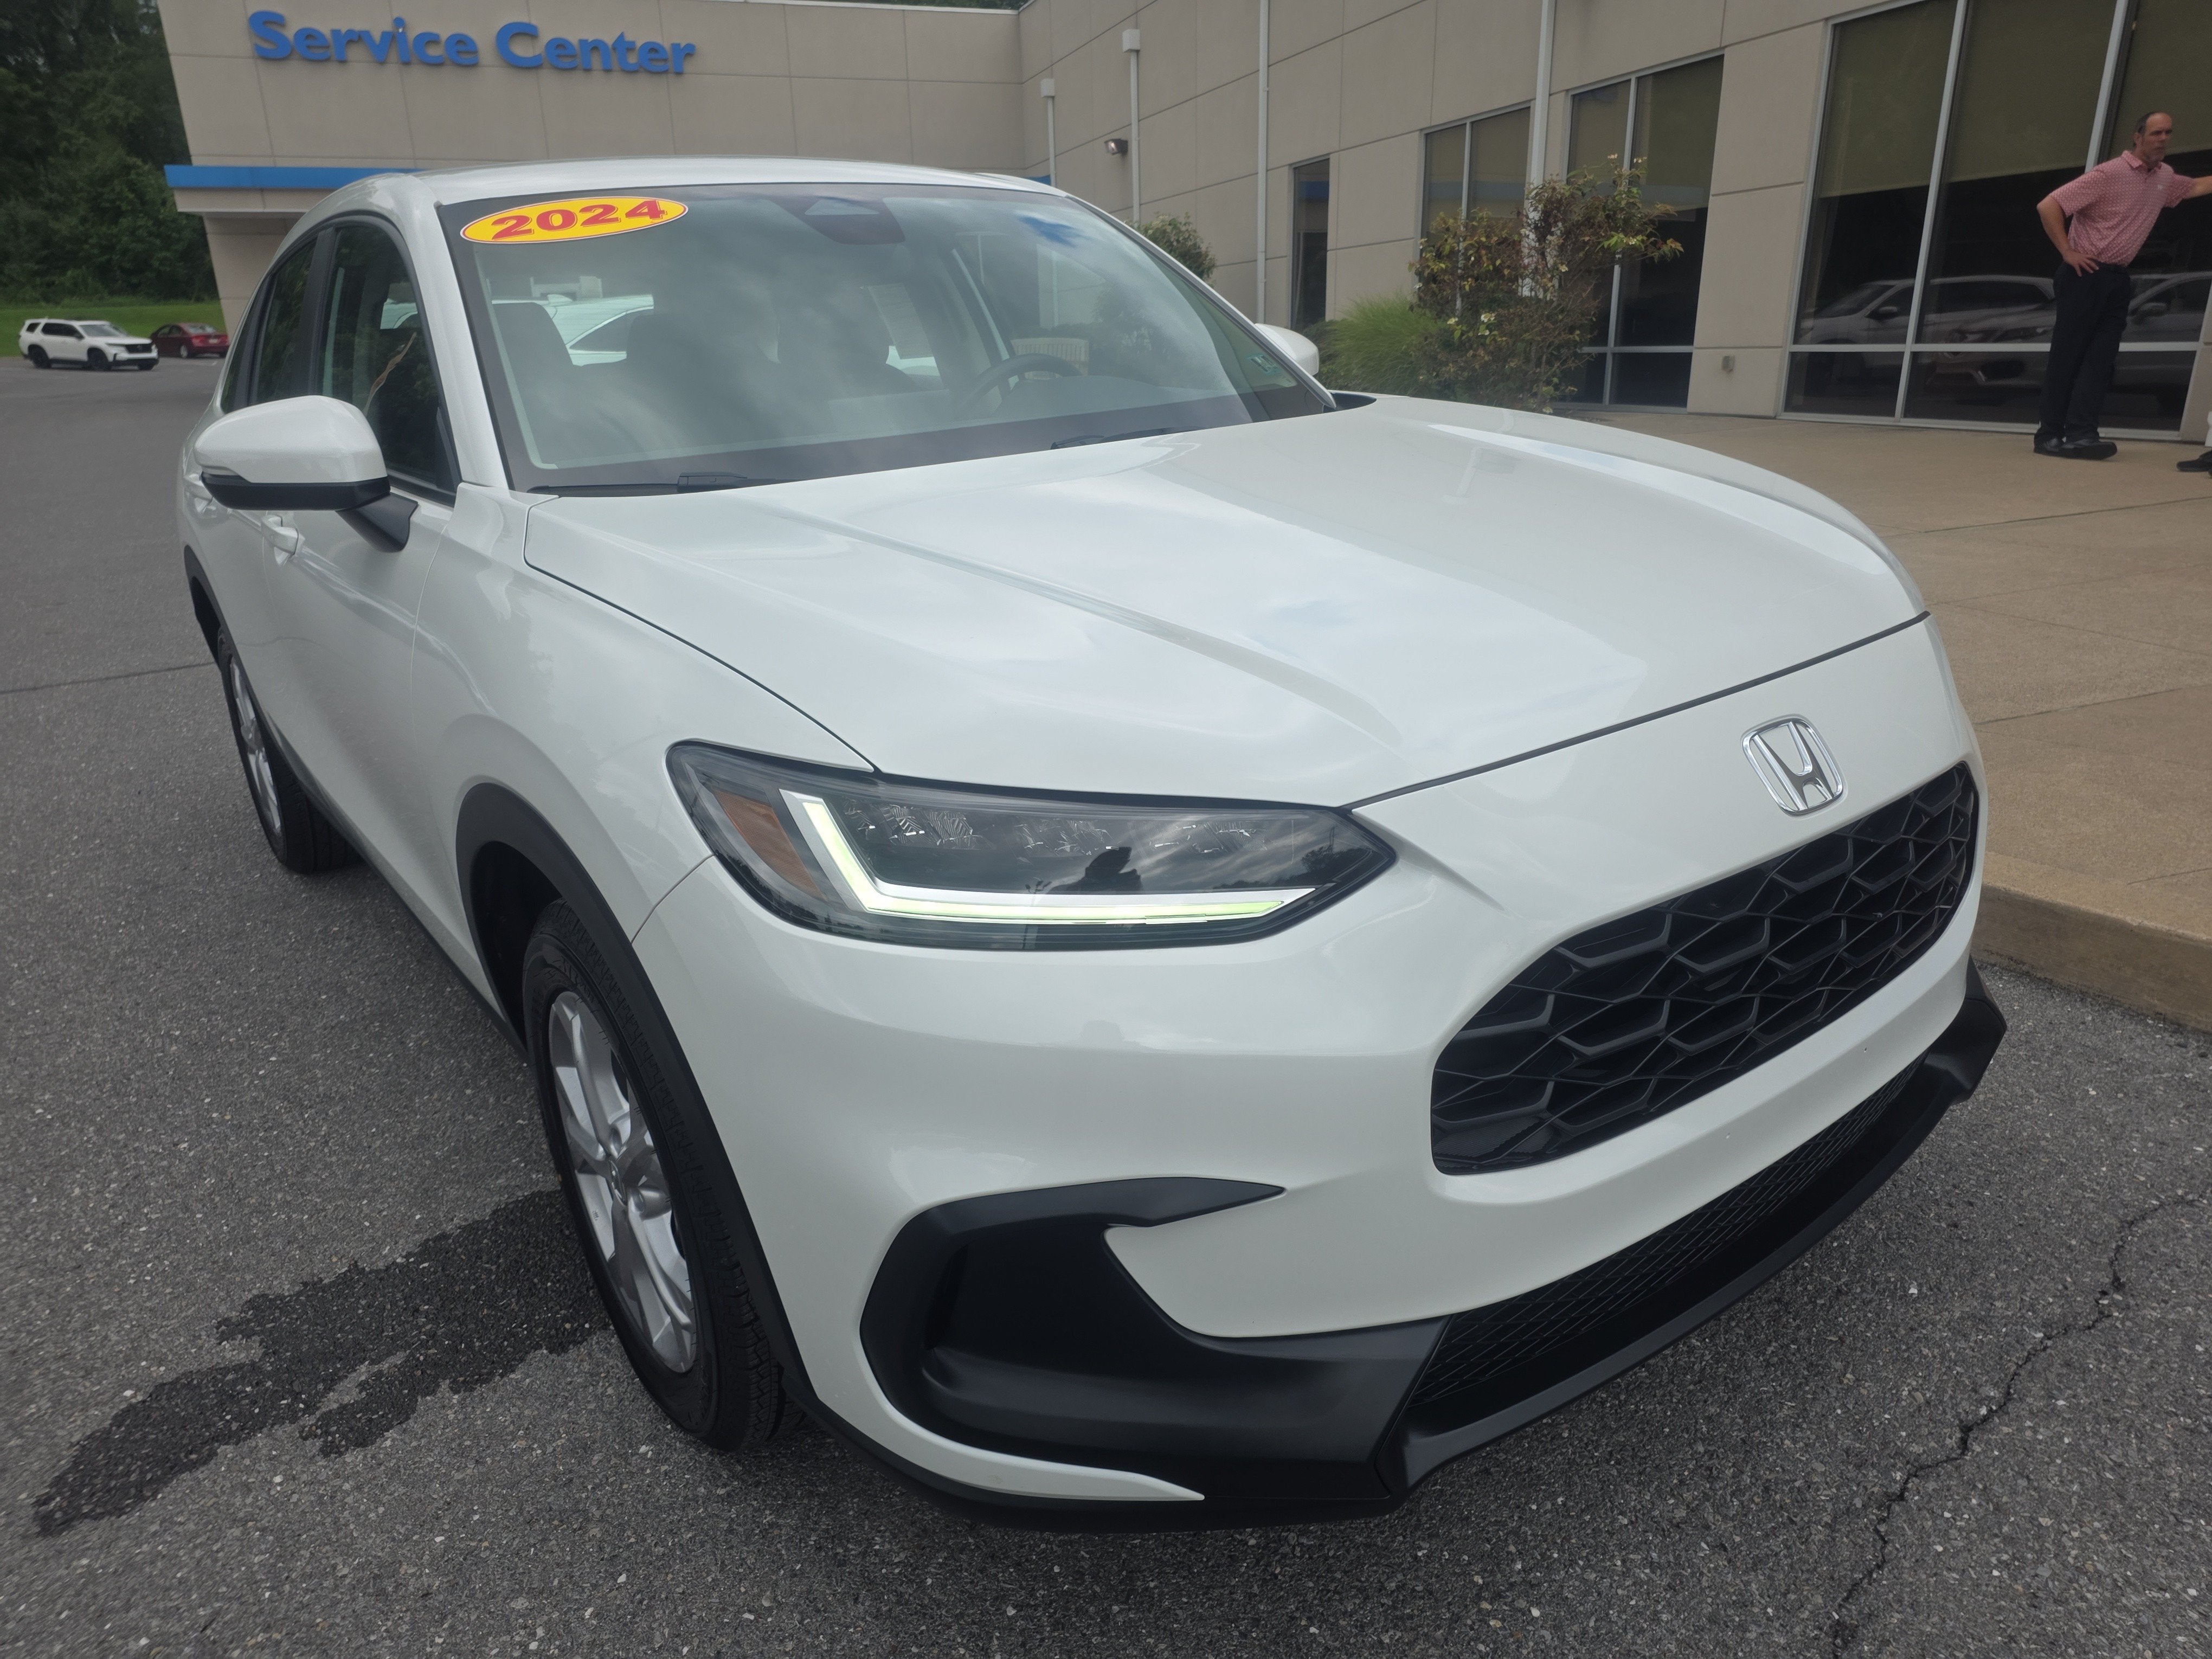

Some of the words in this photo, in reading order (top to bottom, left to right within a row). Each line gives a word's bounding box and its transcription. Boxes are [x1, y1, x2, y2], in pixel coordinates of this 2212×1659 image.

[249, 11, 478, 65] Service
[496, 22, 696, 73] Center
[491, 200, 667, 240] 2024
